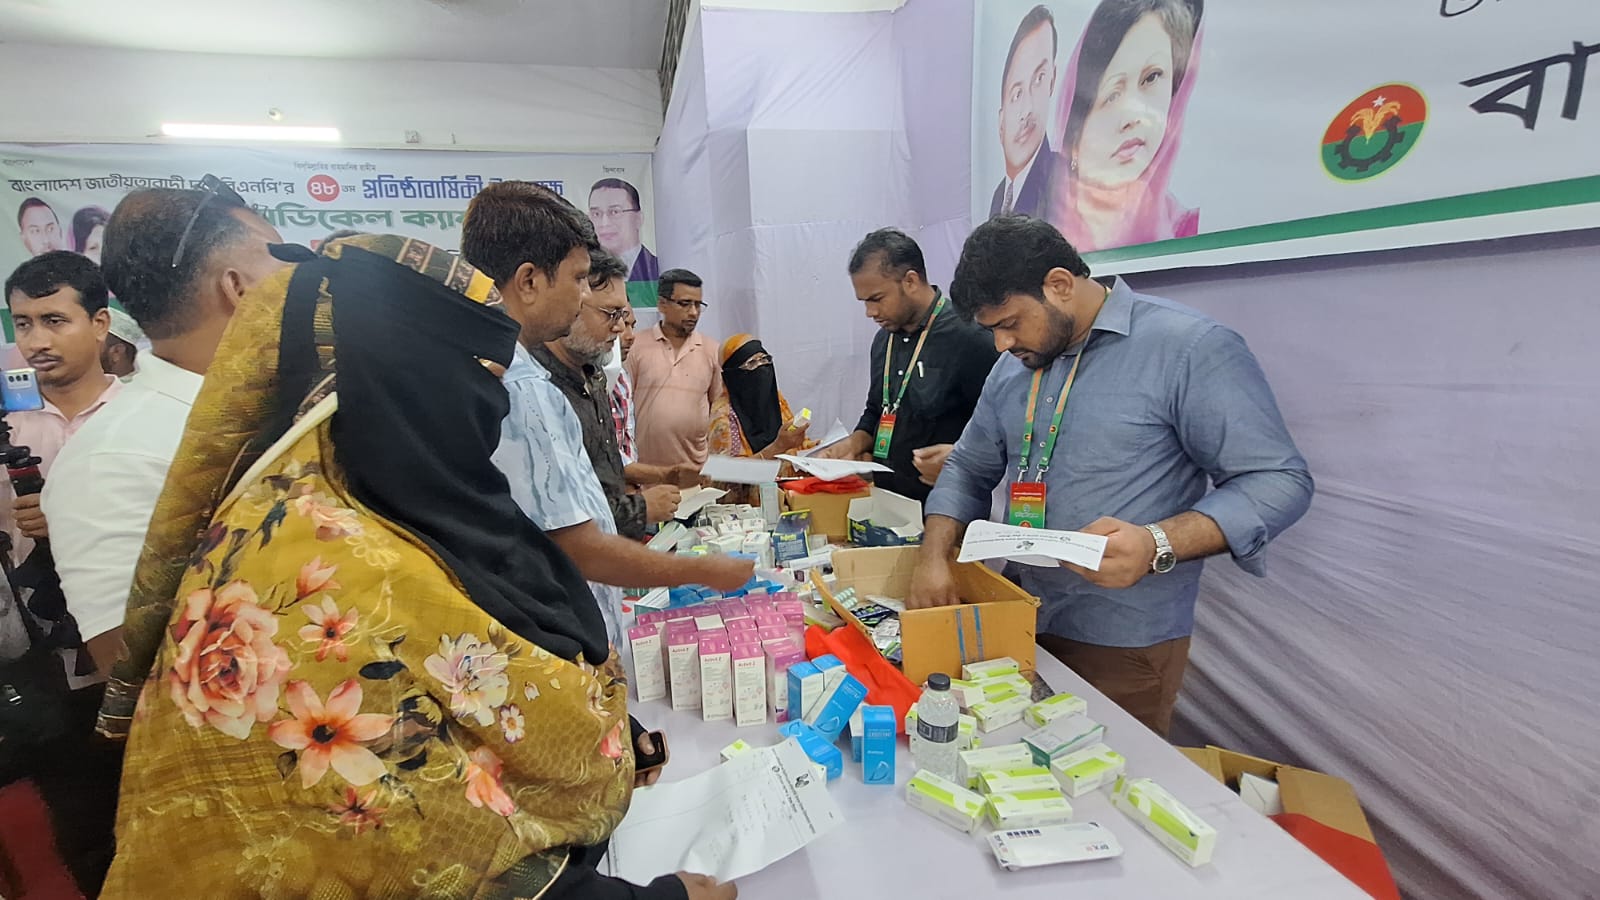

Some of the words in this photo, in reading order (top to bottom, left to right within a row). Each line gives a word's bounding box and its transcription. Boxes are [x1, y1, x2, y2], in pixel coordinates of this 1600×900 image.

[1459, 41, 1600, 131] বা
[8, 178, 82, 192] বাংলাদেশ
[311, 182, 337, 195] ৪৮
[362, 175, 484, 199] প্রতিষ্ঠাবার্ষিকী
